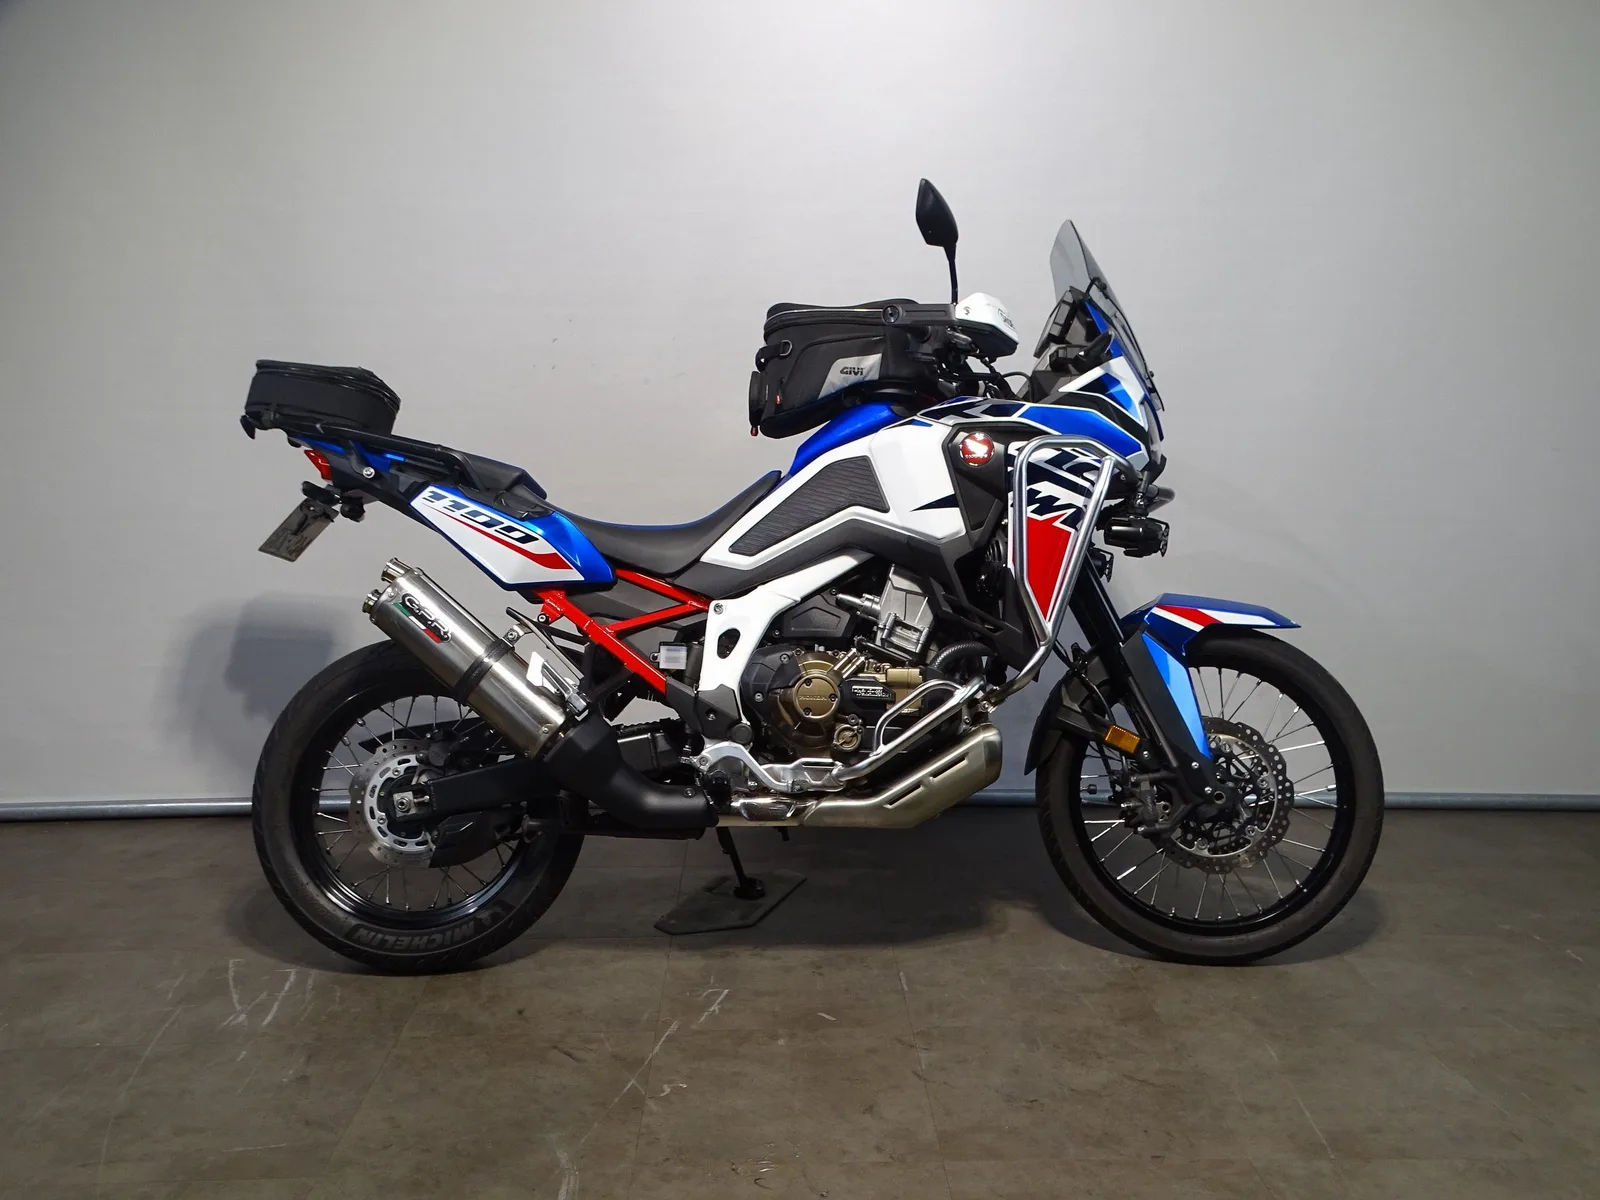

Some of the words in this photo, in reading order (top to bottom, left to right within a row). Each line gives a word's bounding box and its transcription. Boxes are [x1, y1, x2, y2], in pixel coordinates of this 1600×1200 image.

[840, 366, 865, 376] GIVI
[422, 489, 539, 545] 1100
[351, 920, 476, 951] MICHELIN
